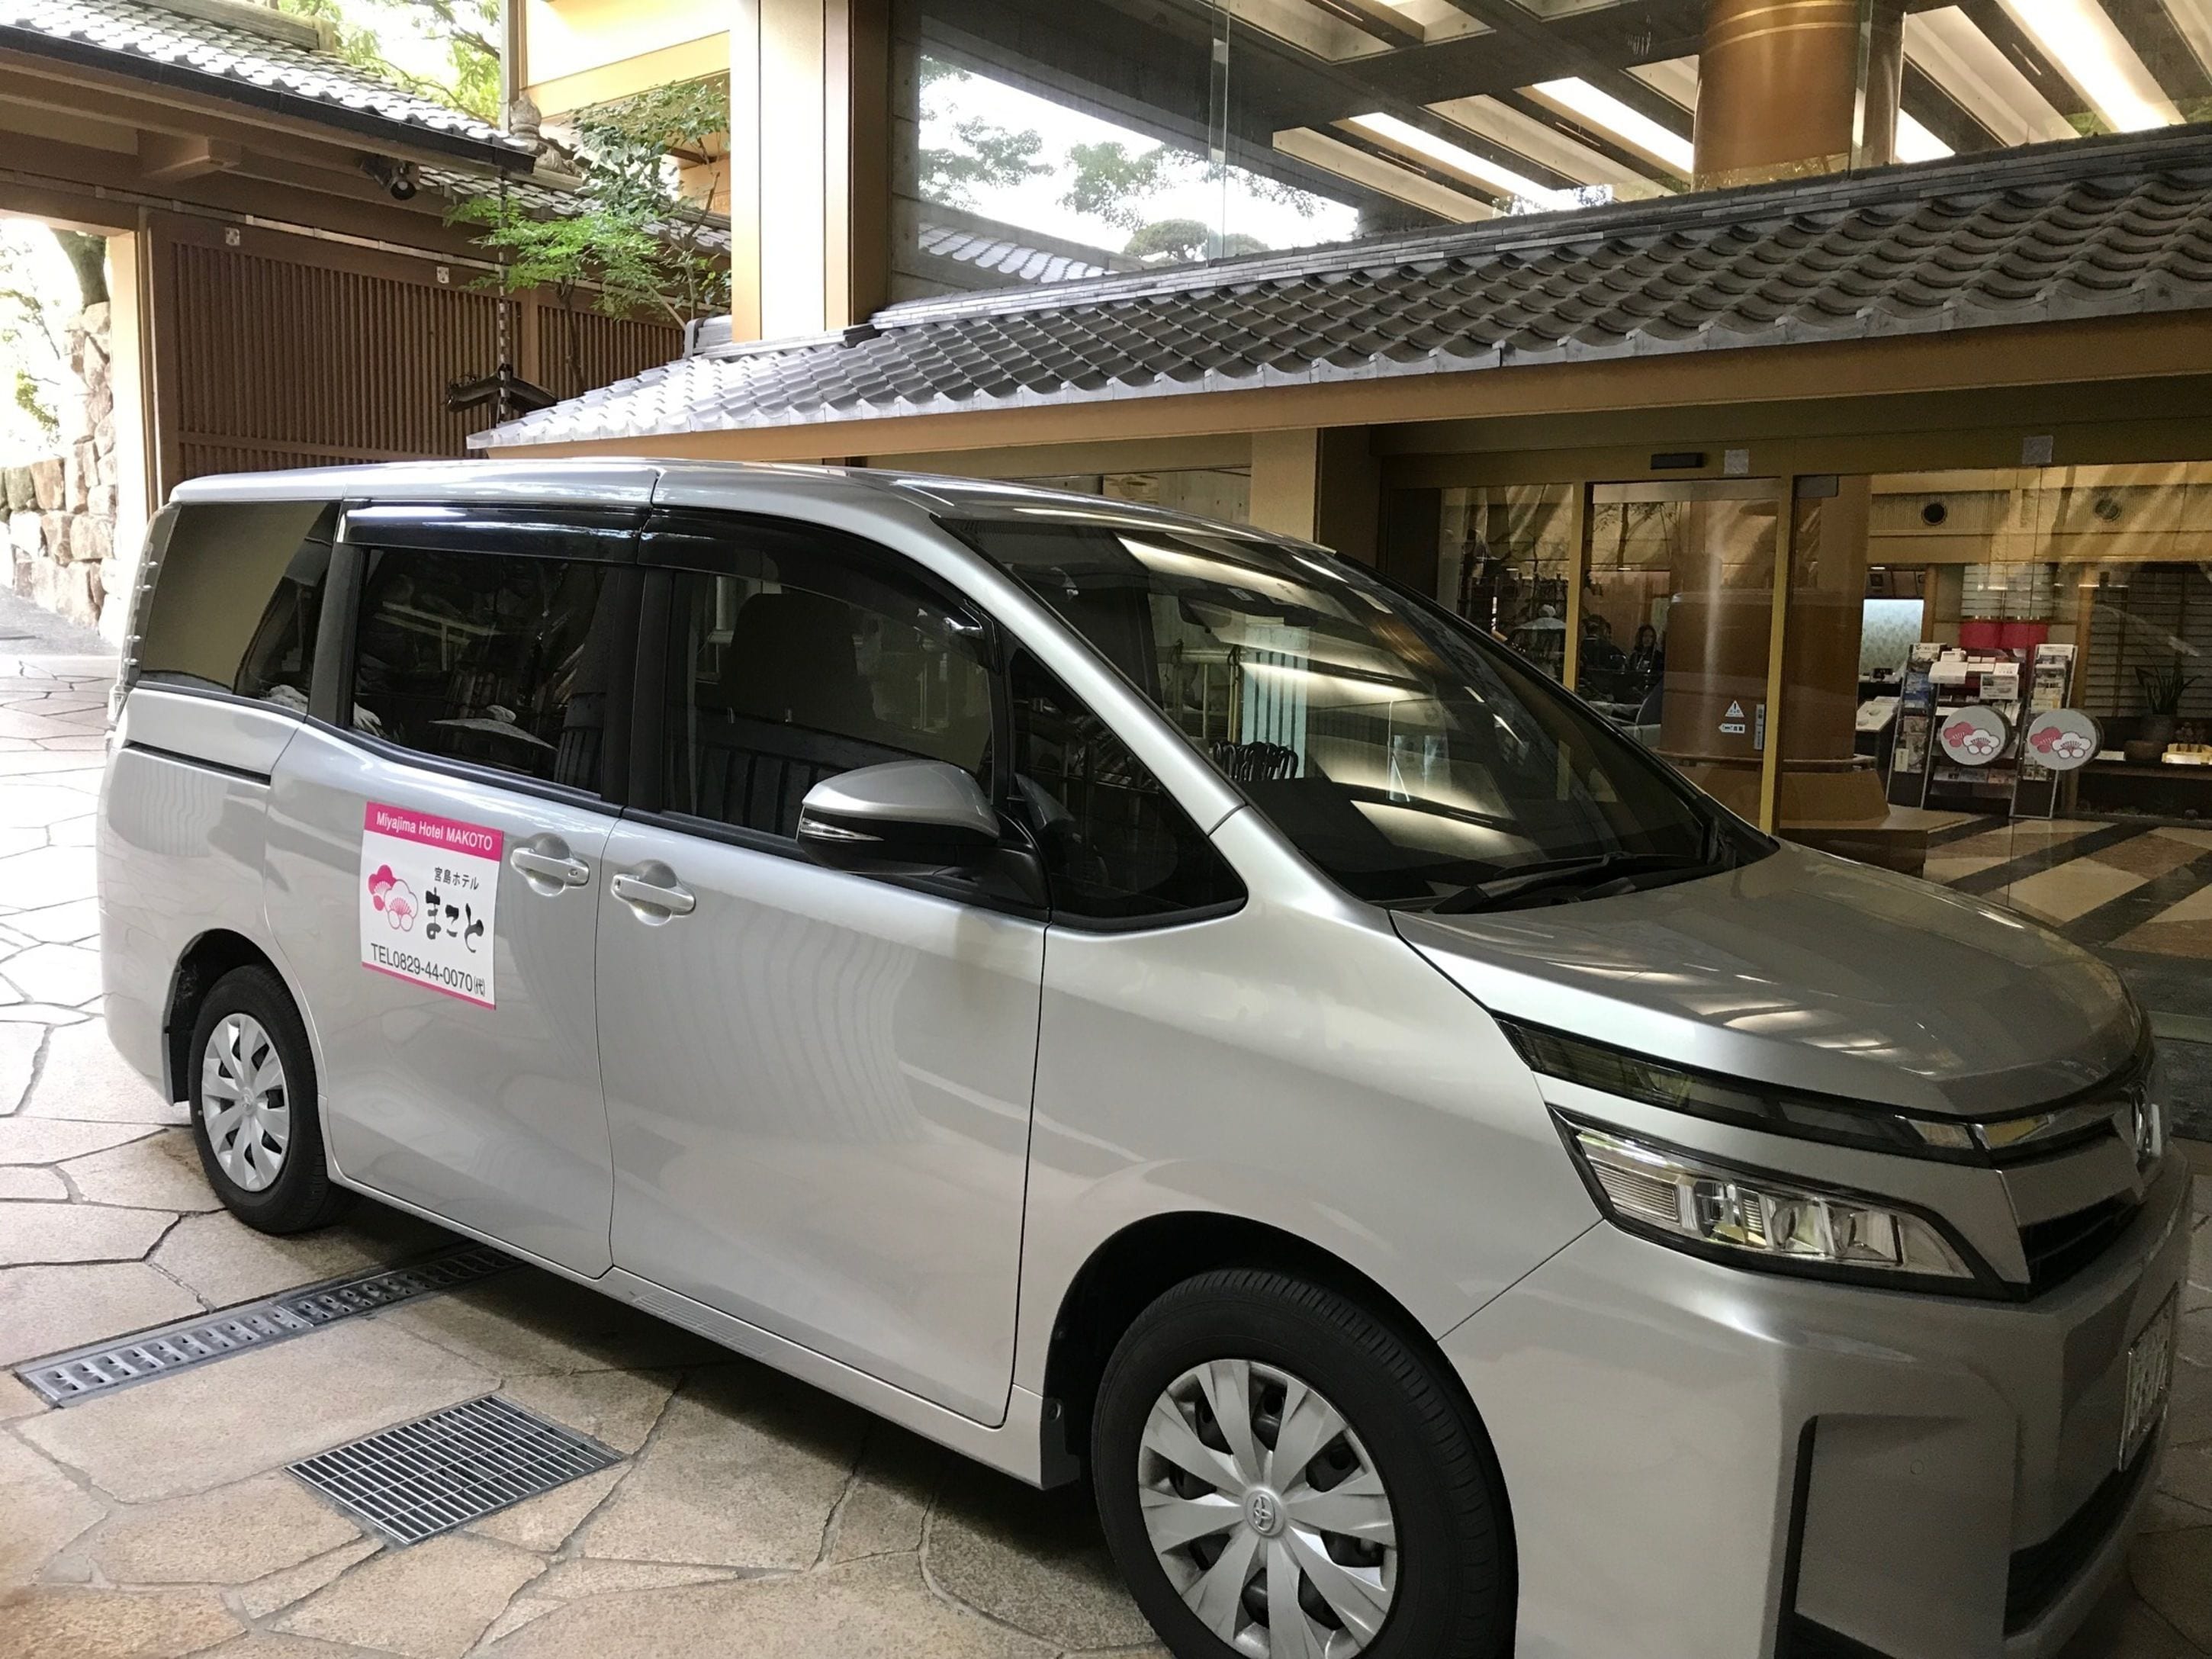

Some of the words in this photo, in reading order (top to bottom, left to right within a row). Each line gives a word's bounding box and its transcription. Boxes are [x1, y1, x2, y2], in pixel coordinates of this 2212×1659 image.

[376, 811, 416, 833] Miyajima
[419, 821, 444, 839] Hotel
[446, 827, 493, 850] MAKOTO
[434, 866, 479, 890] 宮島ホテル
[425, 886, 484, 953] まこと
